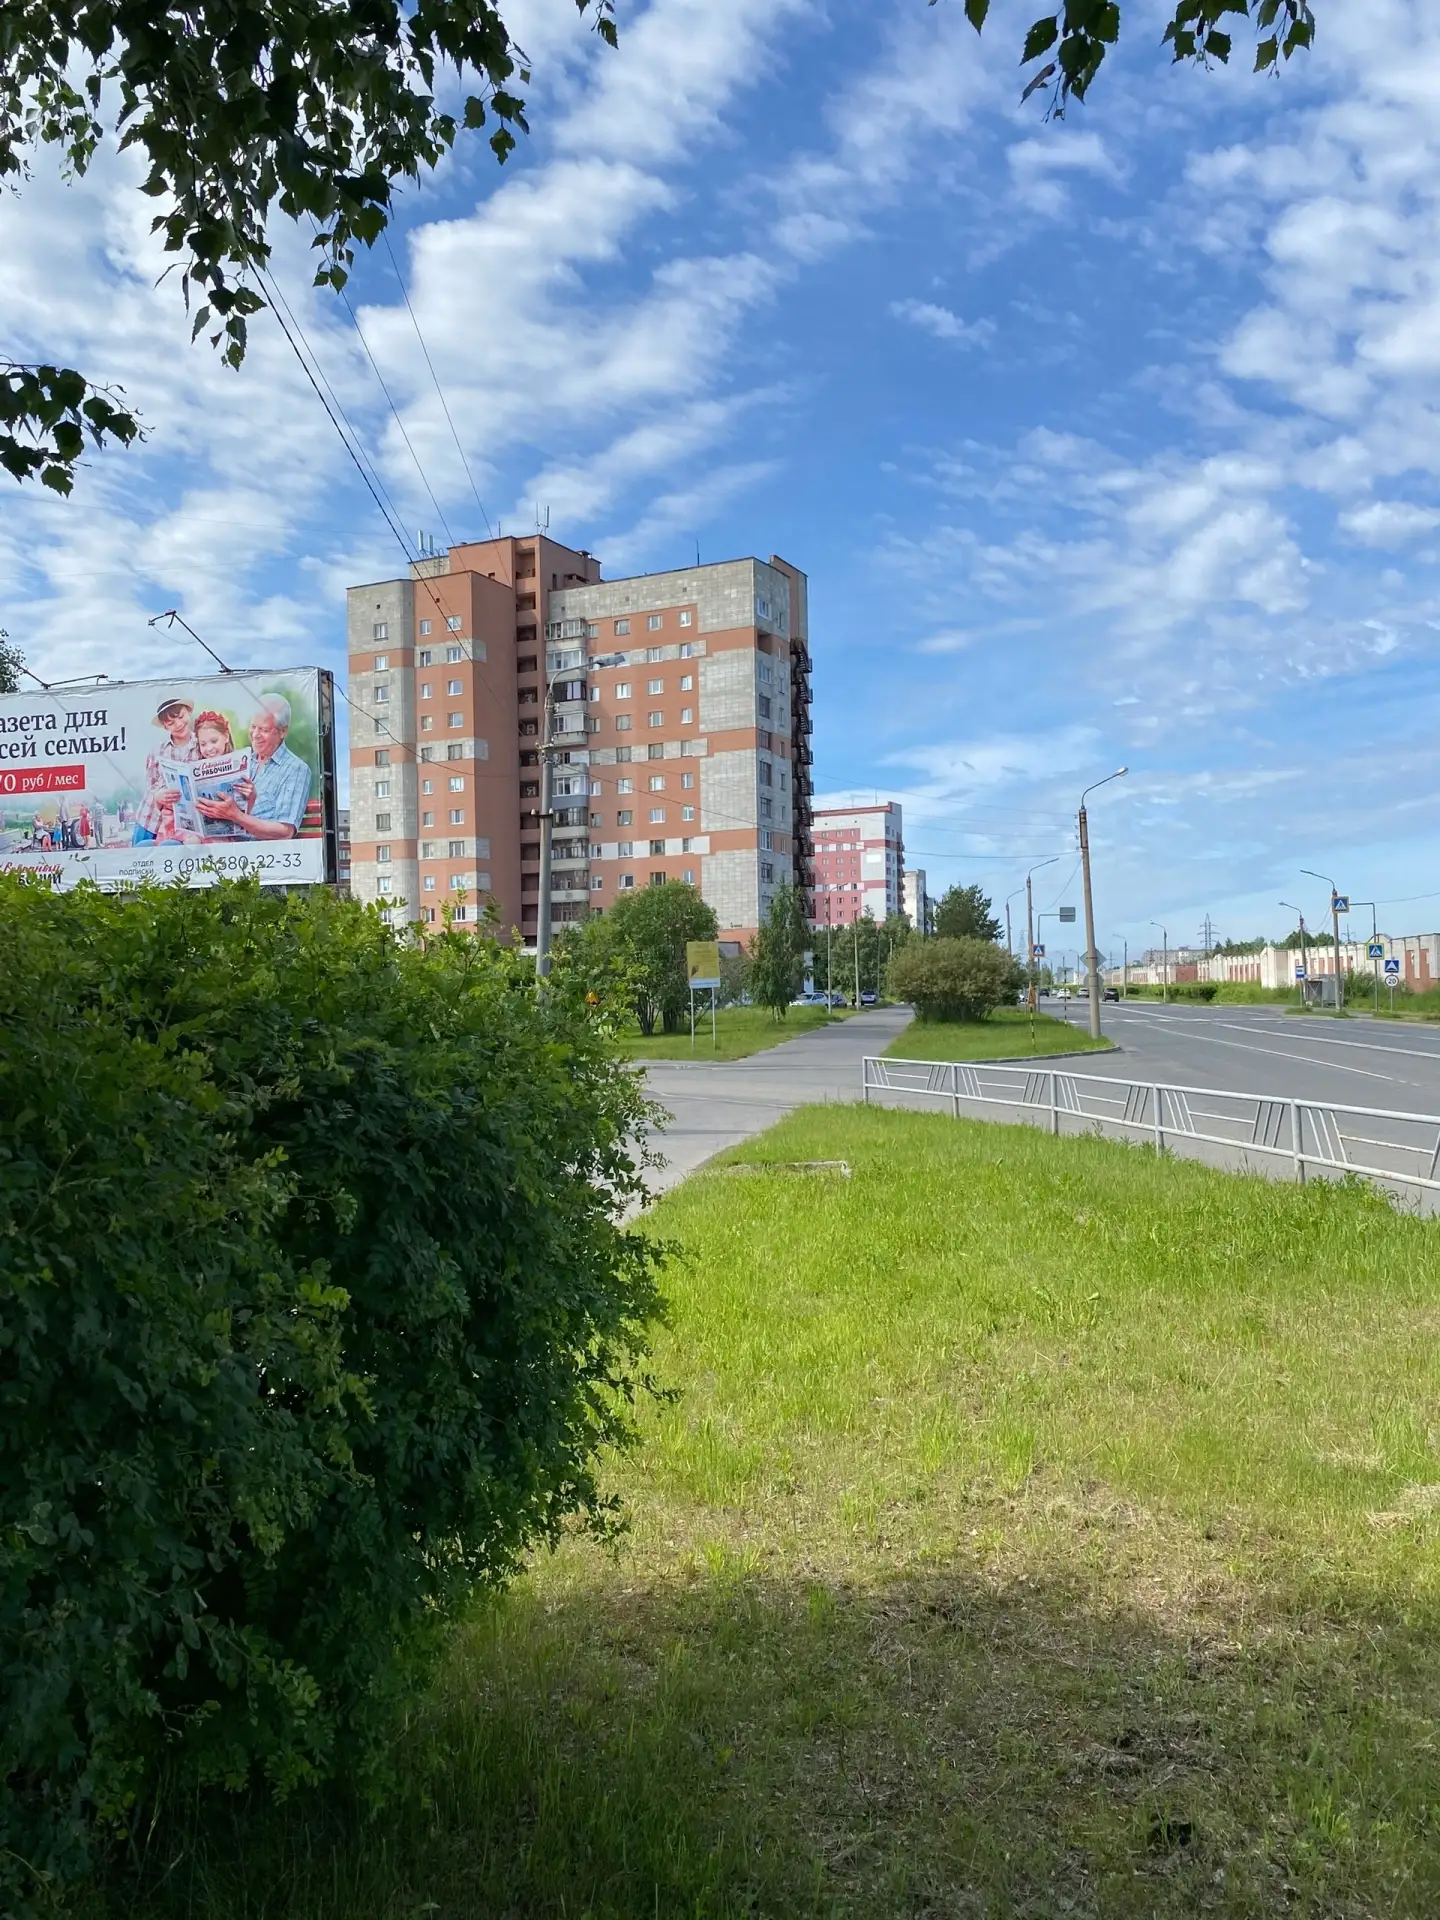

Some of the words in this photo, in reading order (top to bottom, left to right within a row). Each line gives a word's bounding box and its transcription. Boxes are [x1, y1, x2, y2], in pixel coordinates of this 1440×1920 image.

[64, 709, 109, 733] для
[44, 726, 127, 757] семьи!
[0, 773, 17, 792] 0
[22, 773, 44, 791] руб
[54, 774, 79, 786] мес
[163, 859, 173, 873] 8
[218, 853, 302, 871] 580-22-33
